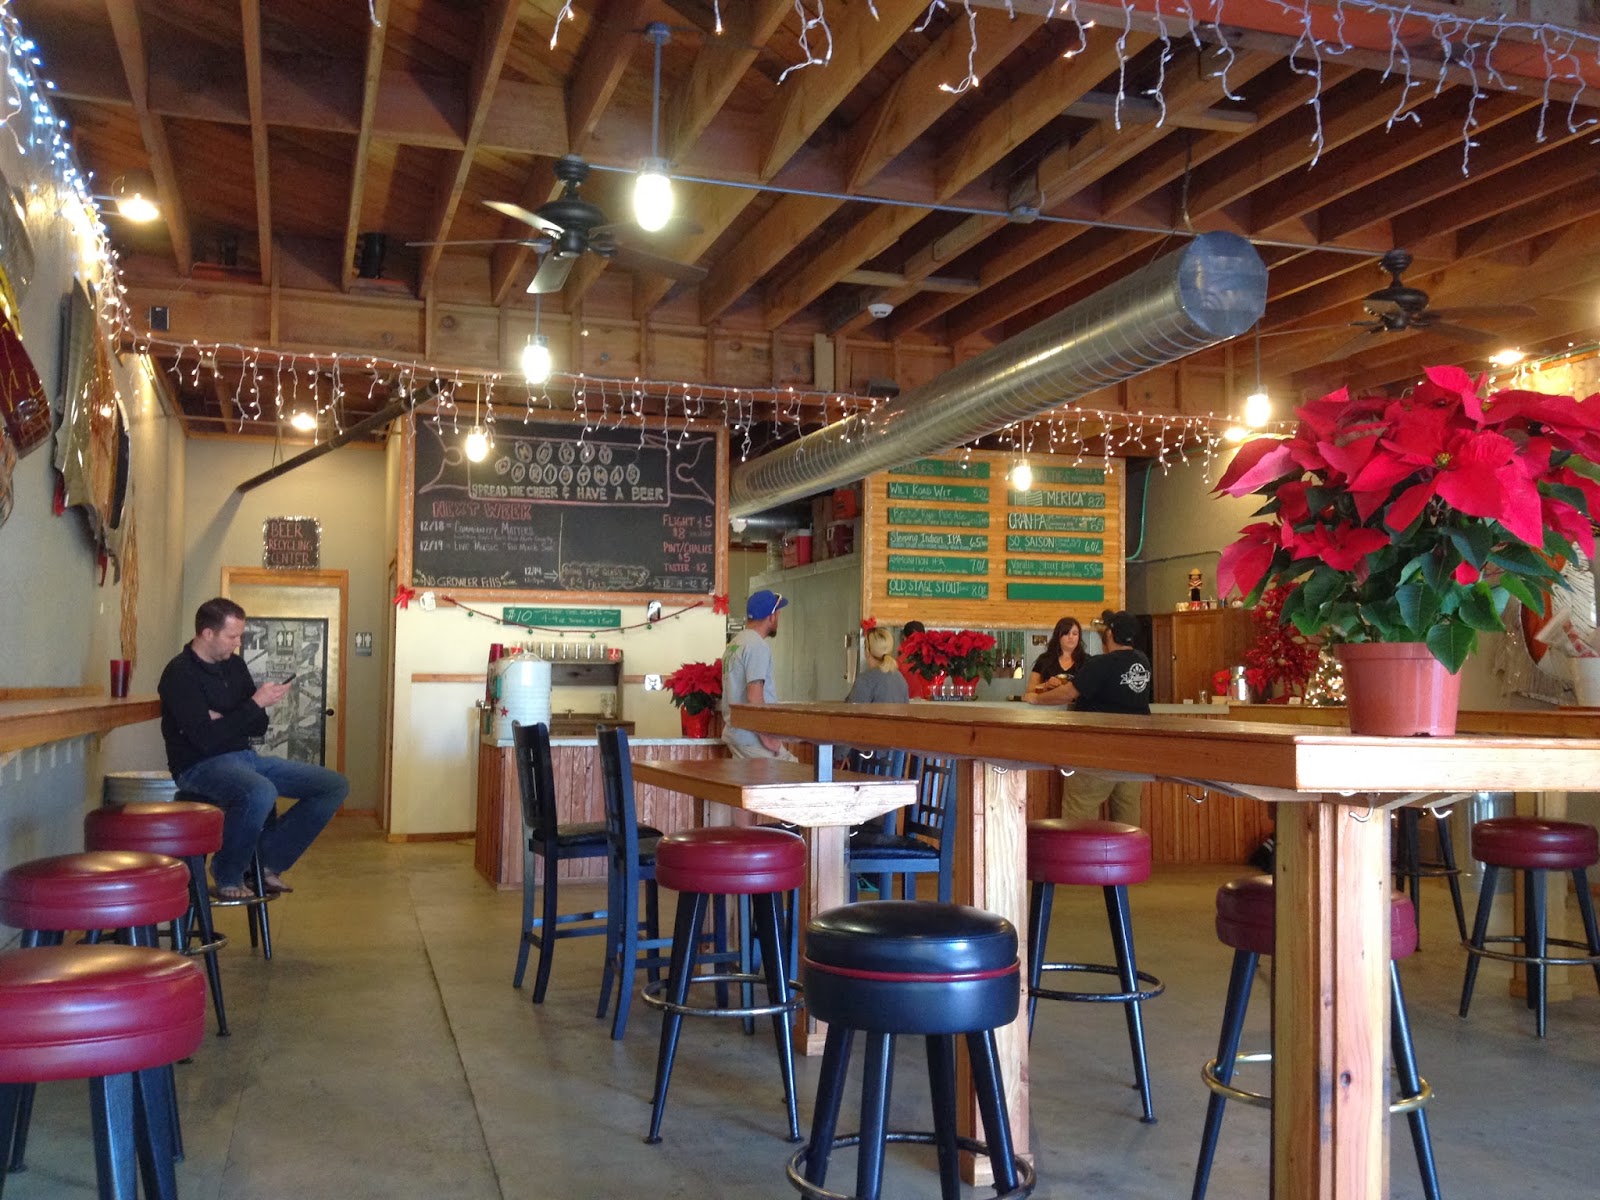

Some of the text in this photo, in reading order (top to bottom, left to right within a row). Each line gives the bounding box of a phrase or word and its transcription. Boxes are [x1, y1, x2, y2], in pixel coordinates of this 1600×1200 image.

[471, 484, 508, 497] SPREAD
[510, 485, 525, 497] THE
[577, 487, 607, 500] HAVE
[615, 487, 624, 500] A
[631, 487, 664, 501] BEER
[432, 501, 532, 520] NEXT WEEK
[420, 521, 444, 532] 12/18
[663, 514, 695, 527] FLIGHT
[704, 515, 713, 528] 5
[271, 522, 303, 539] BEER
[268, 538, 313, 552] RECYCLING
[419, 540, 443, 551] 12/19
[947, 534, 962, 545] IPA
[1025, 536, 1055, 548] SAISON
[271, 551, 310, 565] CENTER
[437, 576, 478, 588] GROWLER
[889, 580, 907, 592] OLD
[935, 581, 961, 594] STOUT
[507, 609, 533, 622] $10
